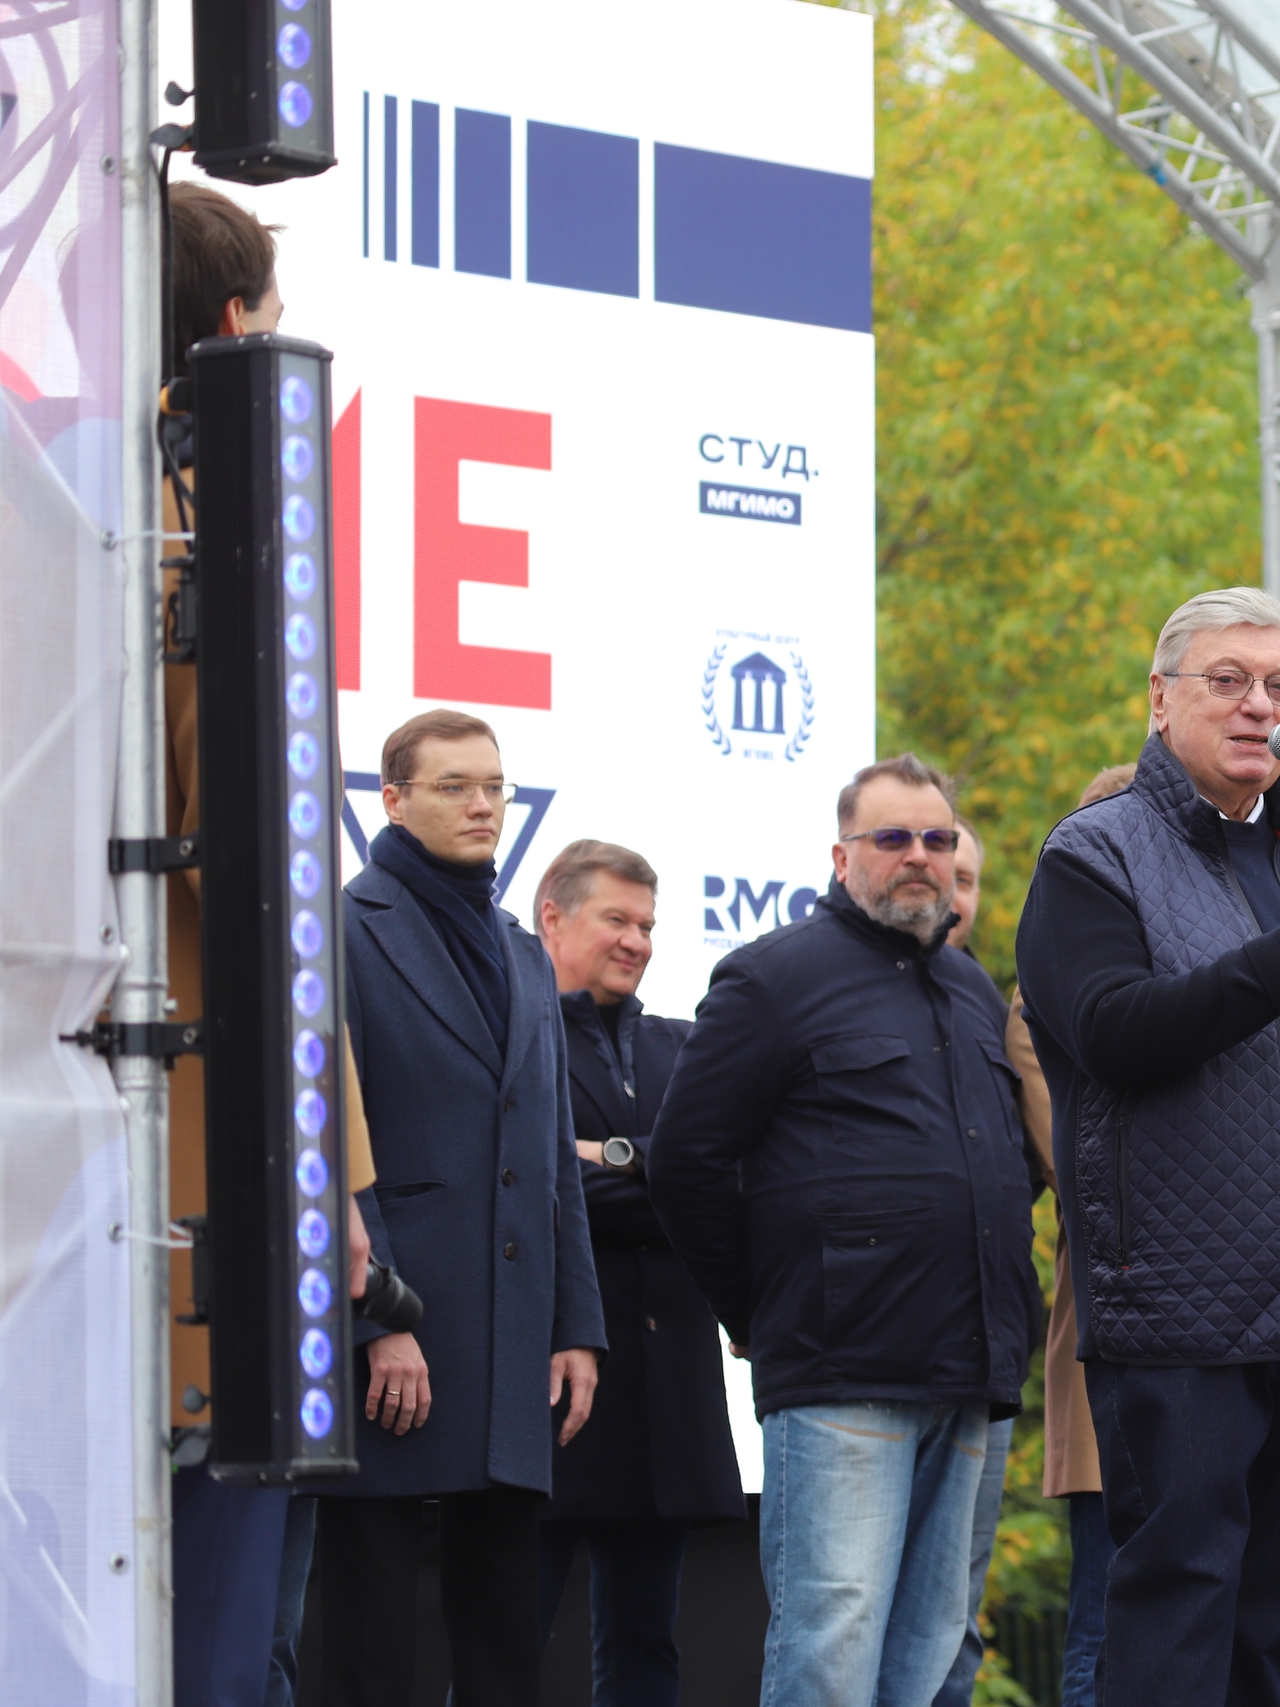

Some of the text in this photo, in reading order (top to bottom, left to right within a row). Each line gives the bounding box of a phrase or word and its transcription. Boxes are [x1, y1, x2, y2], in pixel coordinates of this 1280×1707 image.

[699, 432, 819, 482] СТУД.
[707, 488, 796, 520] МГИМО
[332, 385, 552, 712] E
